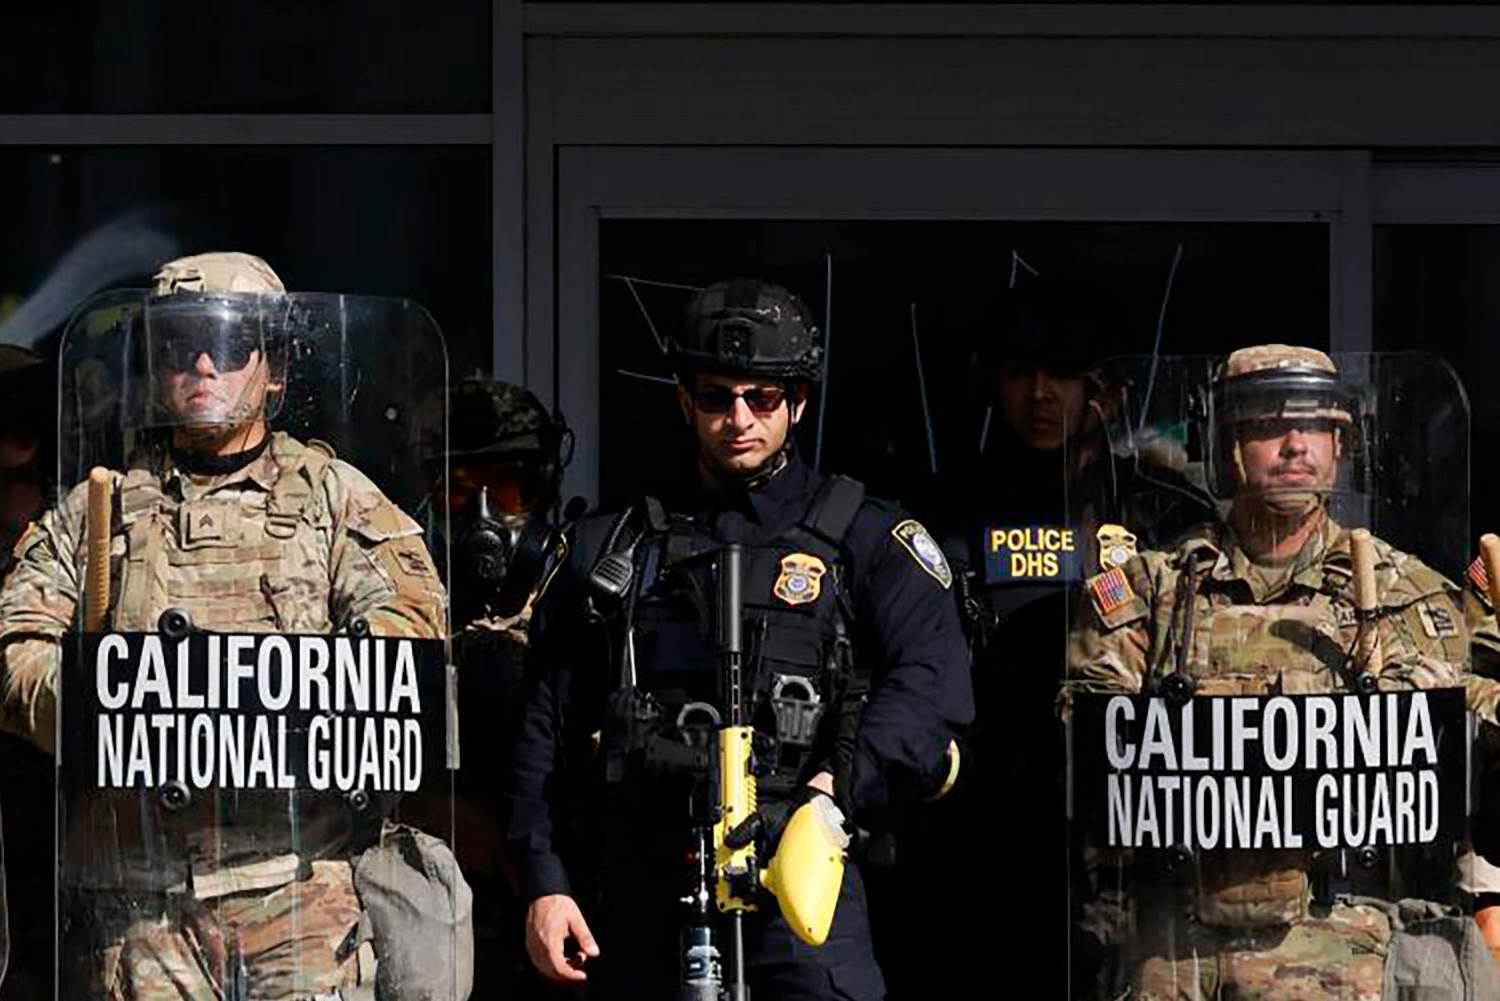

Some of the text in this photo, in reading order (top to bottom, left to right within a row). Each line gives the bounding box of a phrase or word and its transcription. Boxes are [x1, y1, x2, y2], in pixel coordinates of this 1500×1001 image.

[991, 528, 1075, 552] POLICE
[1011, 552, 1059, 577] DHS
[96, 633, 421, 714] CALIFORNIA
[97, 713, 423, 792] NATIONAL GUARD
[1105, 691, 1438, 772] CALIFORNIA
[1108, 769, 1439, 850] NATIONAL GUARD
